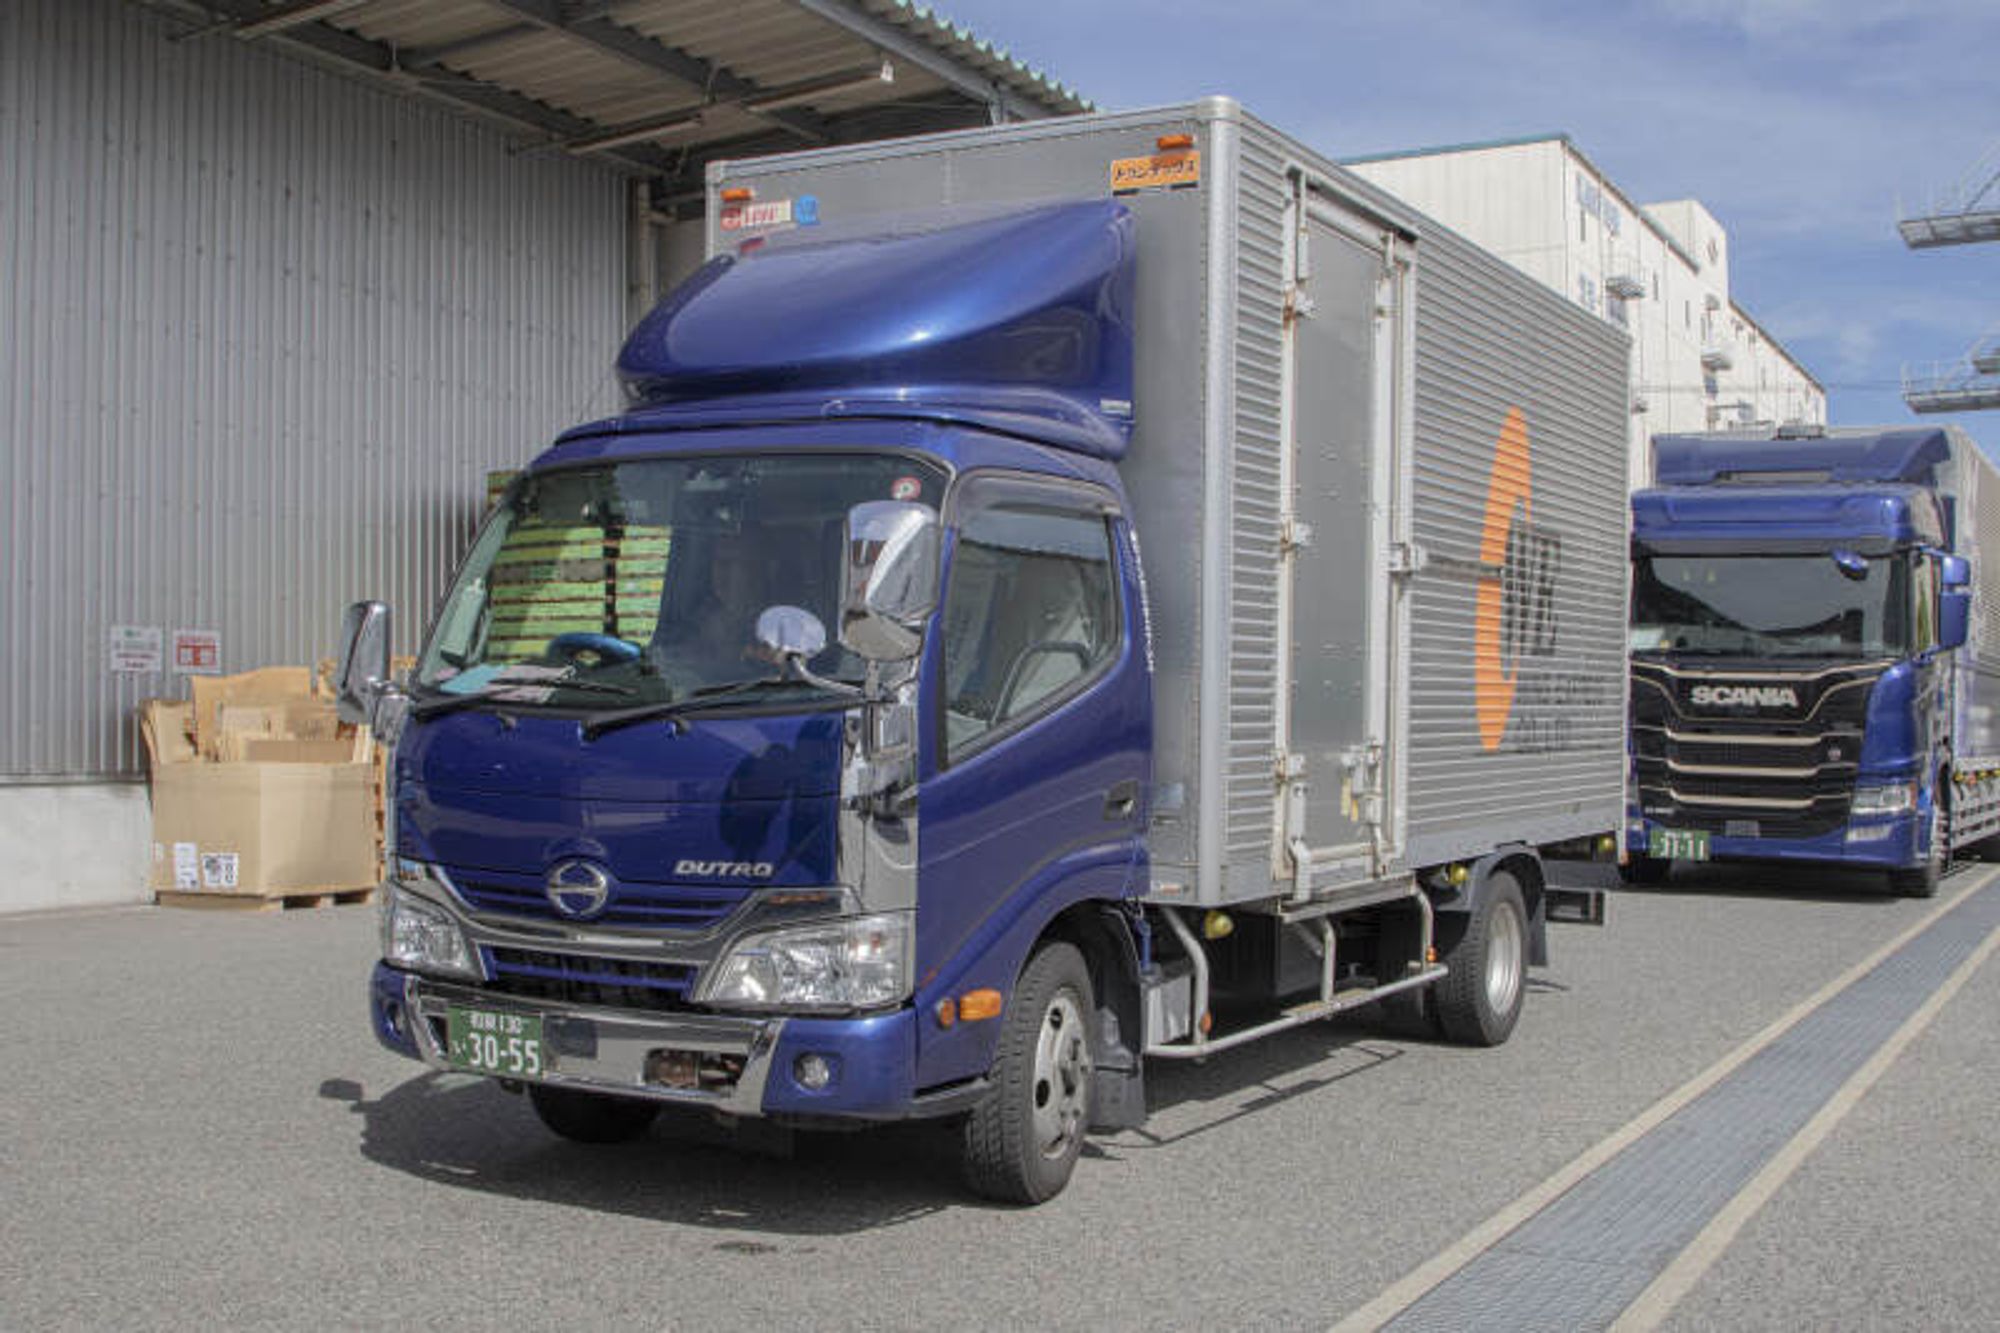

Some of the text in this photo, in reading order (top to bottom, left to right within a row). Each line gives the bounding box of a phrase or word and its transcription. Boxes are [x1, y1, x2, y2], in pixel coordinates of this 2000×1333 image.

[1691, 686, 1798, 708] SCANIA
[673, 859, 774, 877] DUTRO
[468, 1032, 540, 1075] 30-55
